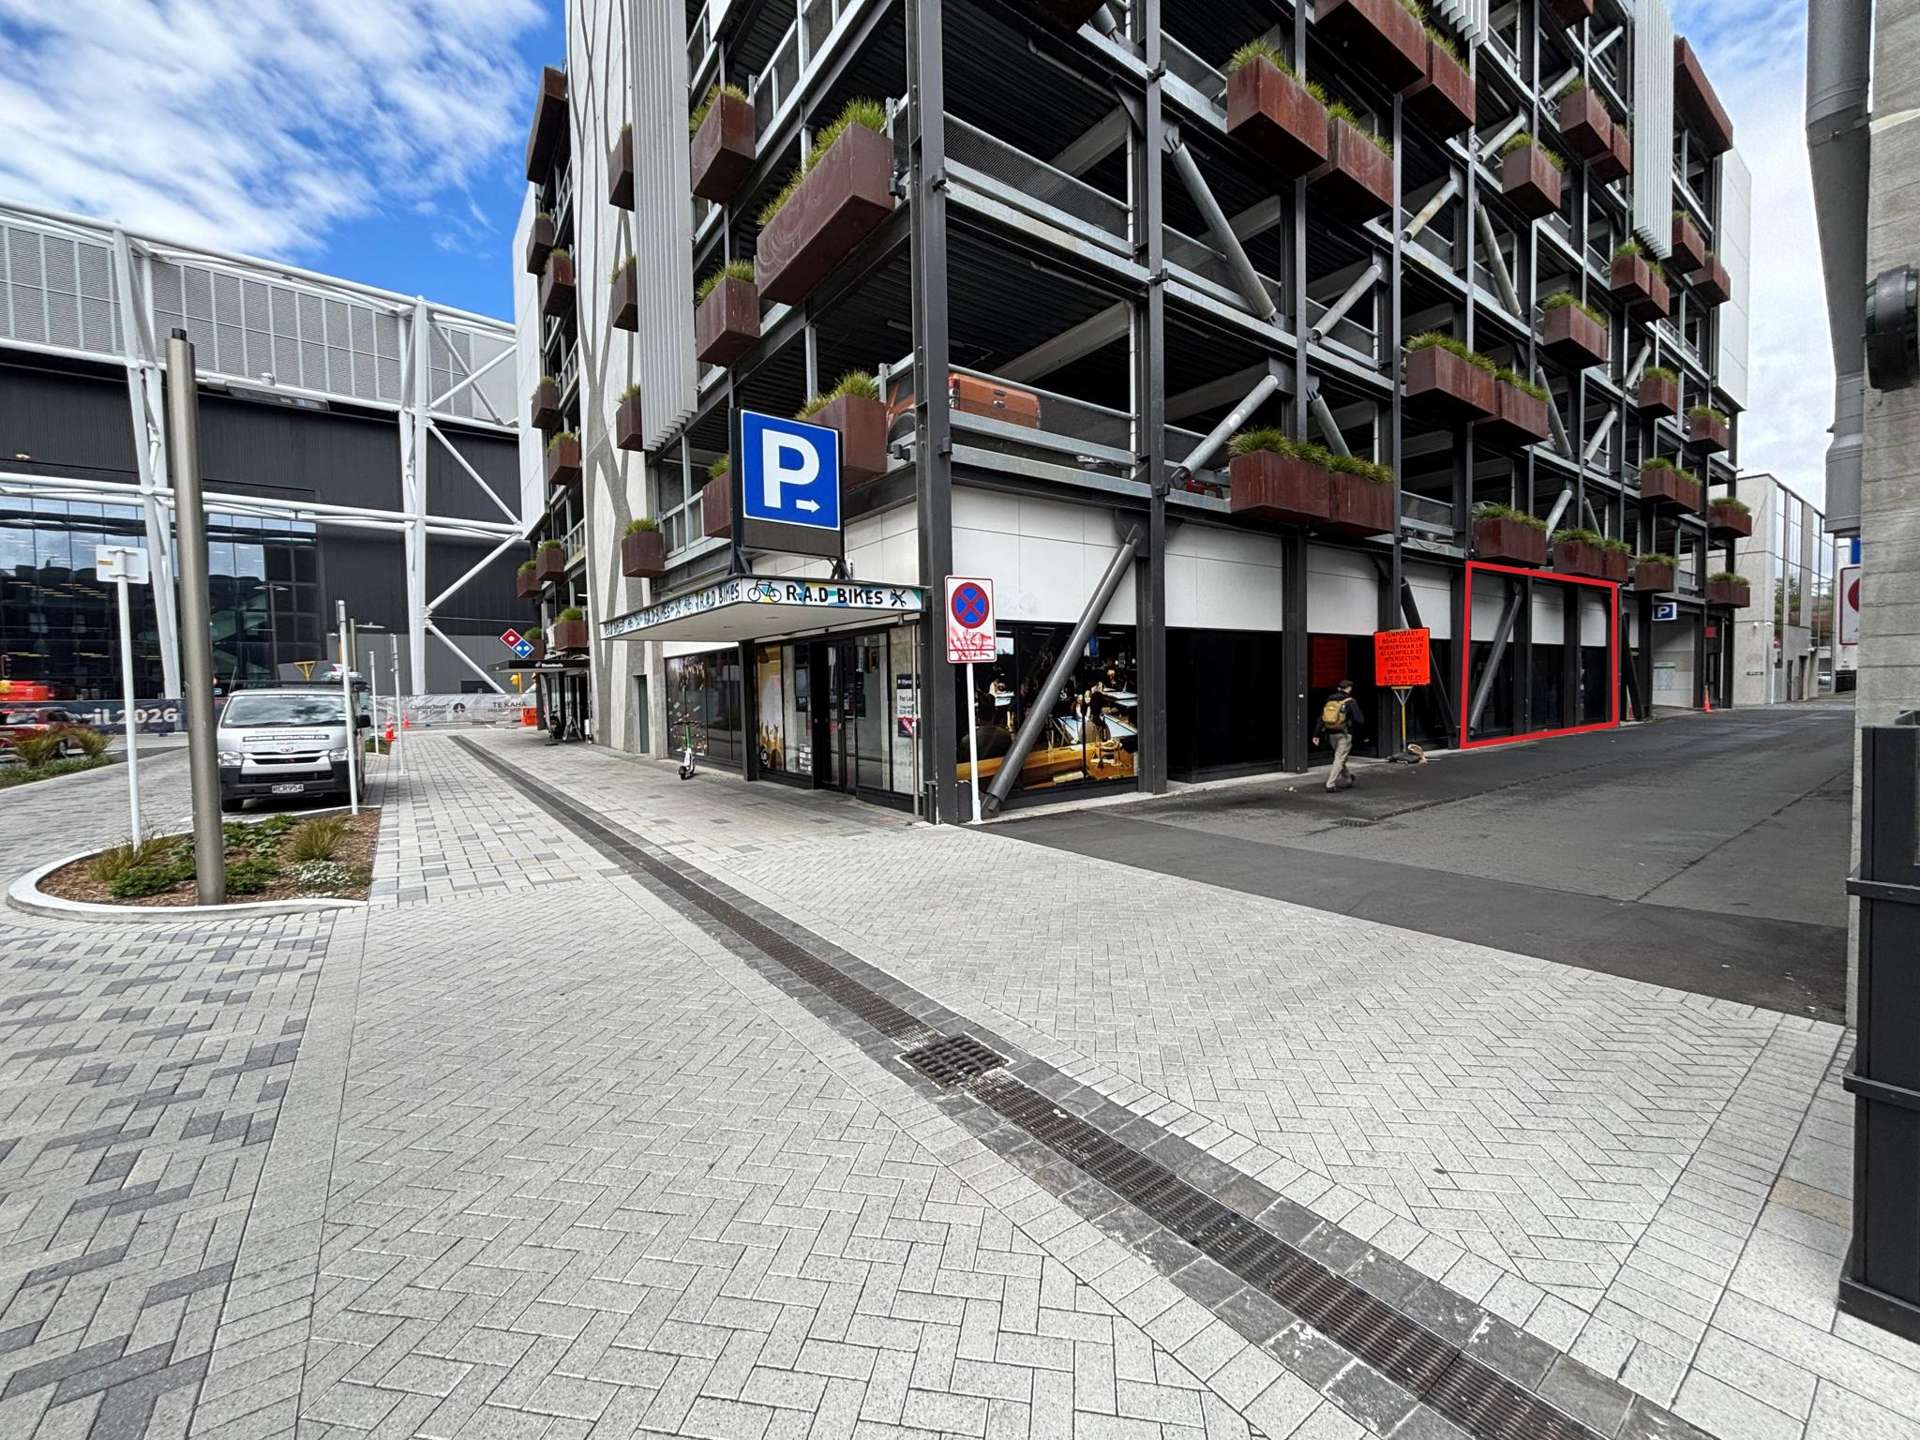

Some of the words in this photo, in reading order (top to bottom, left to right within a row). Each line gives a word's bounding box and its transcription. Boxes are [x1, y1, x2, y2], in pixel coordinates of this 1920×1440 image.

[762, 428, 820, 509] P
[719, 582, 740, 604] BIKES
[786, 584, 829, 603] R.A.D
[837, 588, 884, 605] BIKES
[1658, 606, 1670, 618] P
[82, 708, 112, 725] ril
[116, 707, 178, 724] 2026
